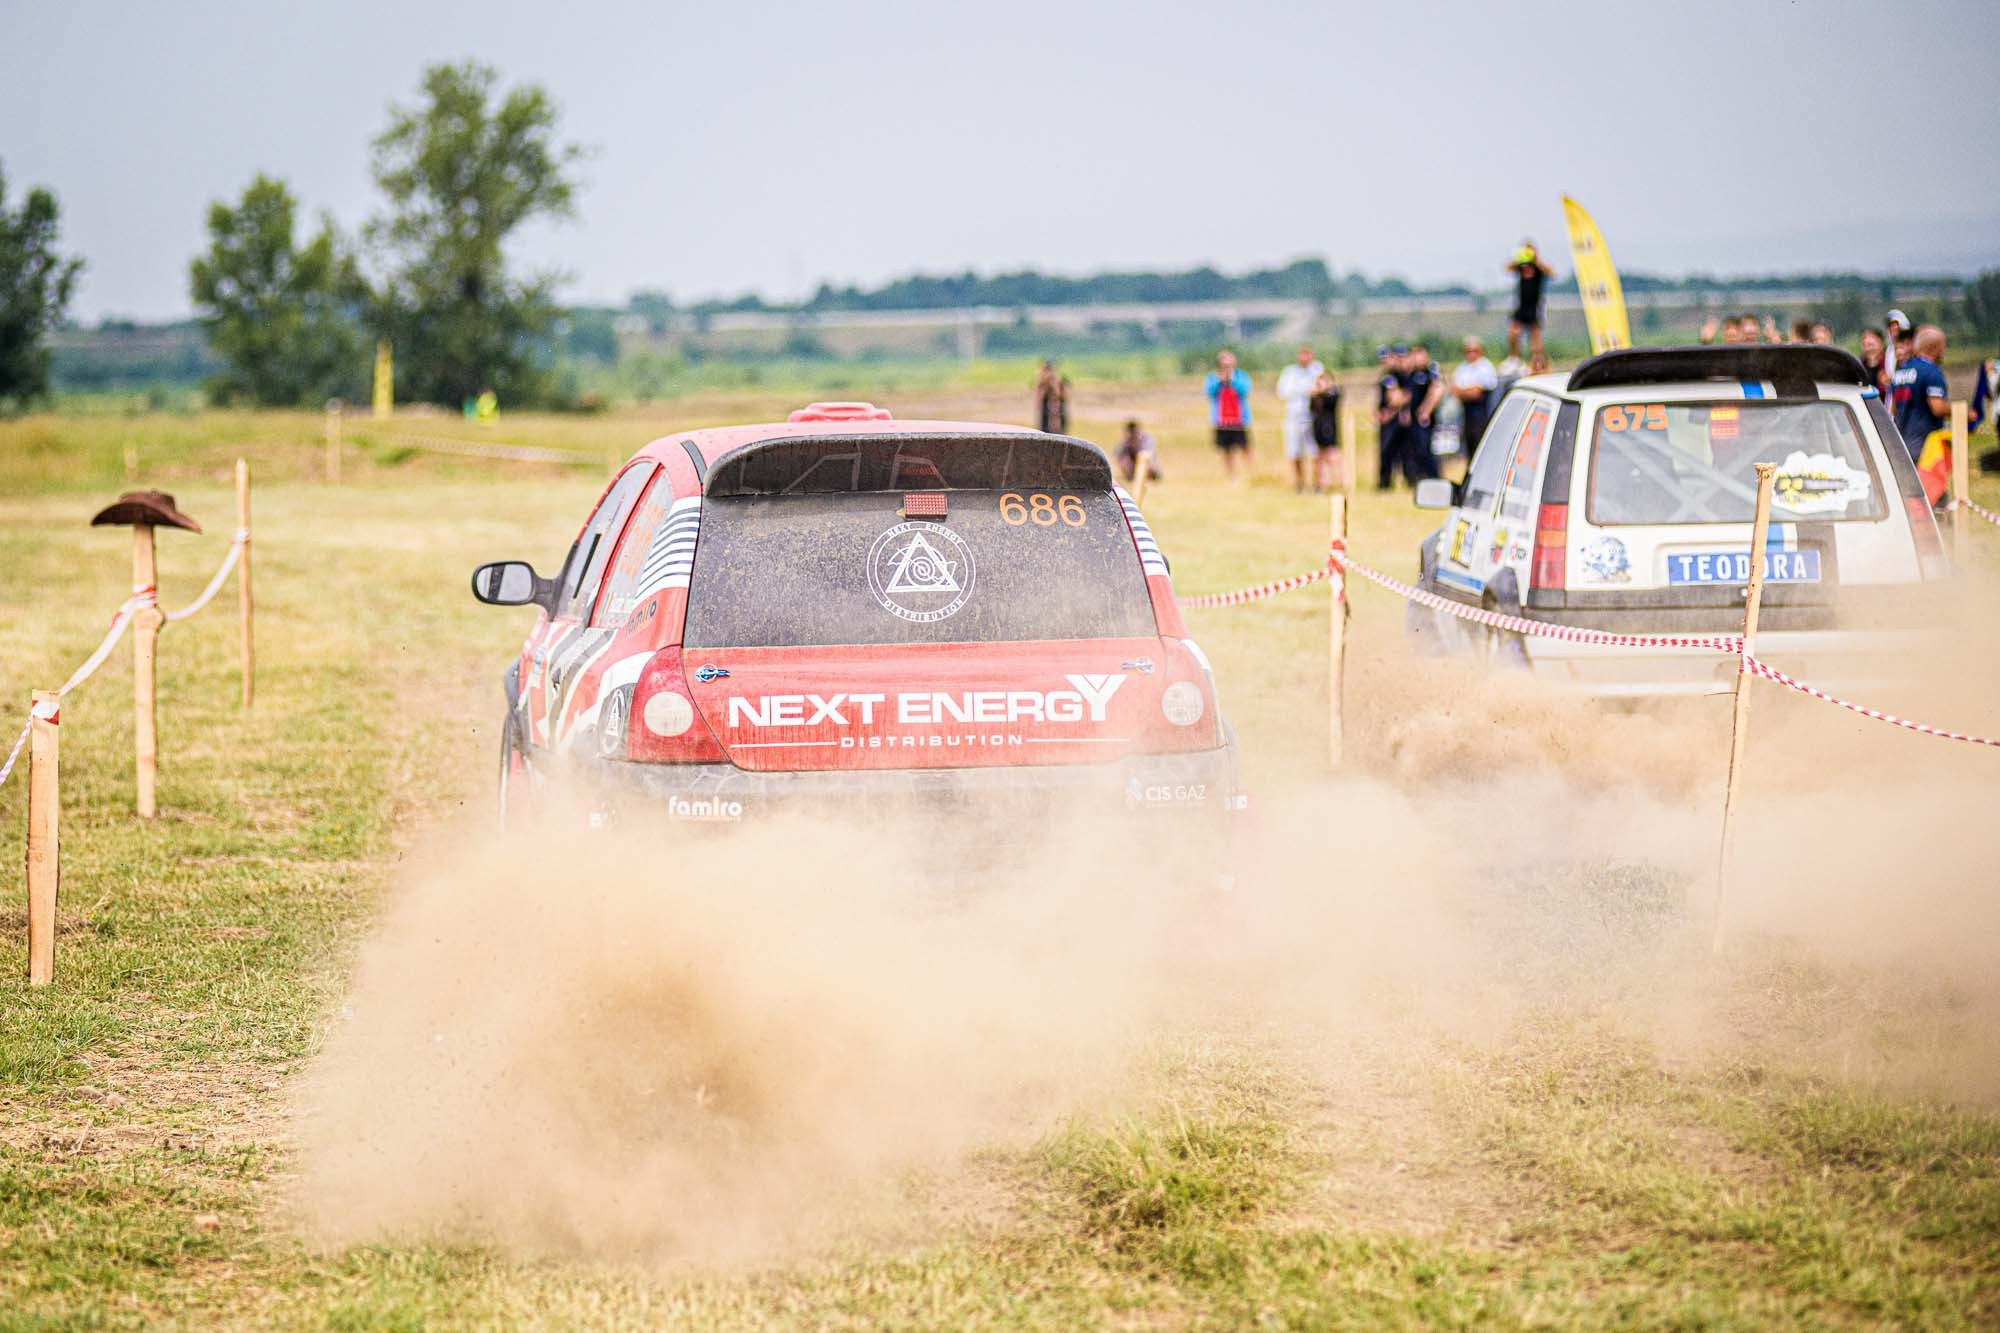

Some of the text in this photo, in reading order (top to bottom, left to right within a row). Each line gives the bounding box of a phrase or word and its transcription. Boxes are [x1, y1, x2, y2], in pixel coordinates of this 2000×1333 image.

[1603, 404, 1669, 432] 675
[999, 493, 1087, 527] 686
[887, 523, 963, 545] NEXT ENERGY
[883, 598, 963, 621] DISTRIBUTION
[728, 673, 1129, 728] NEXT ENERGY
[840, 734, 1023, 749] DISTRIBUTION
[1144, 784, 1207, 801] CIS GAZ
